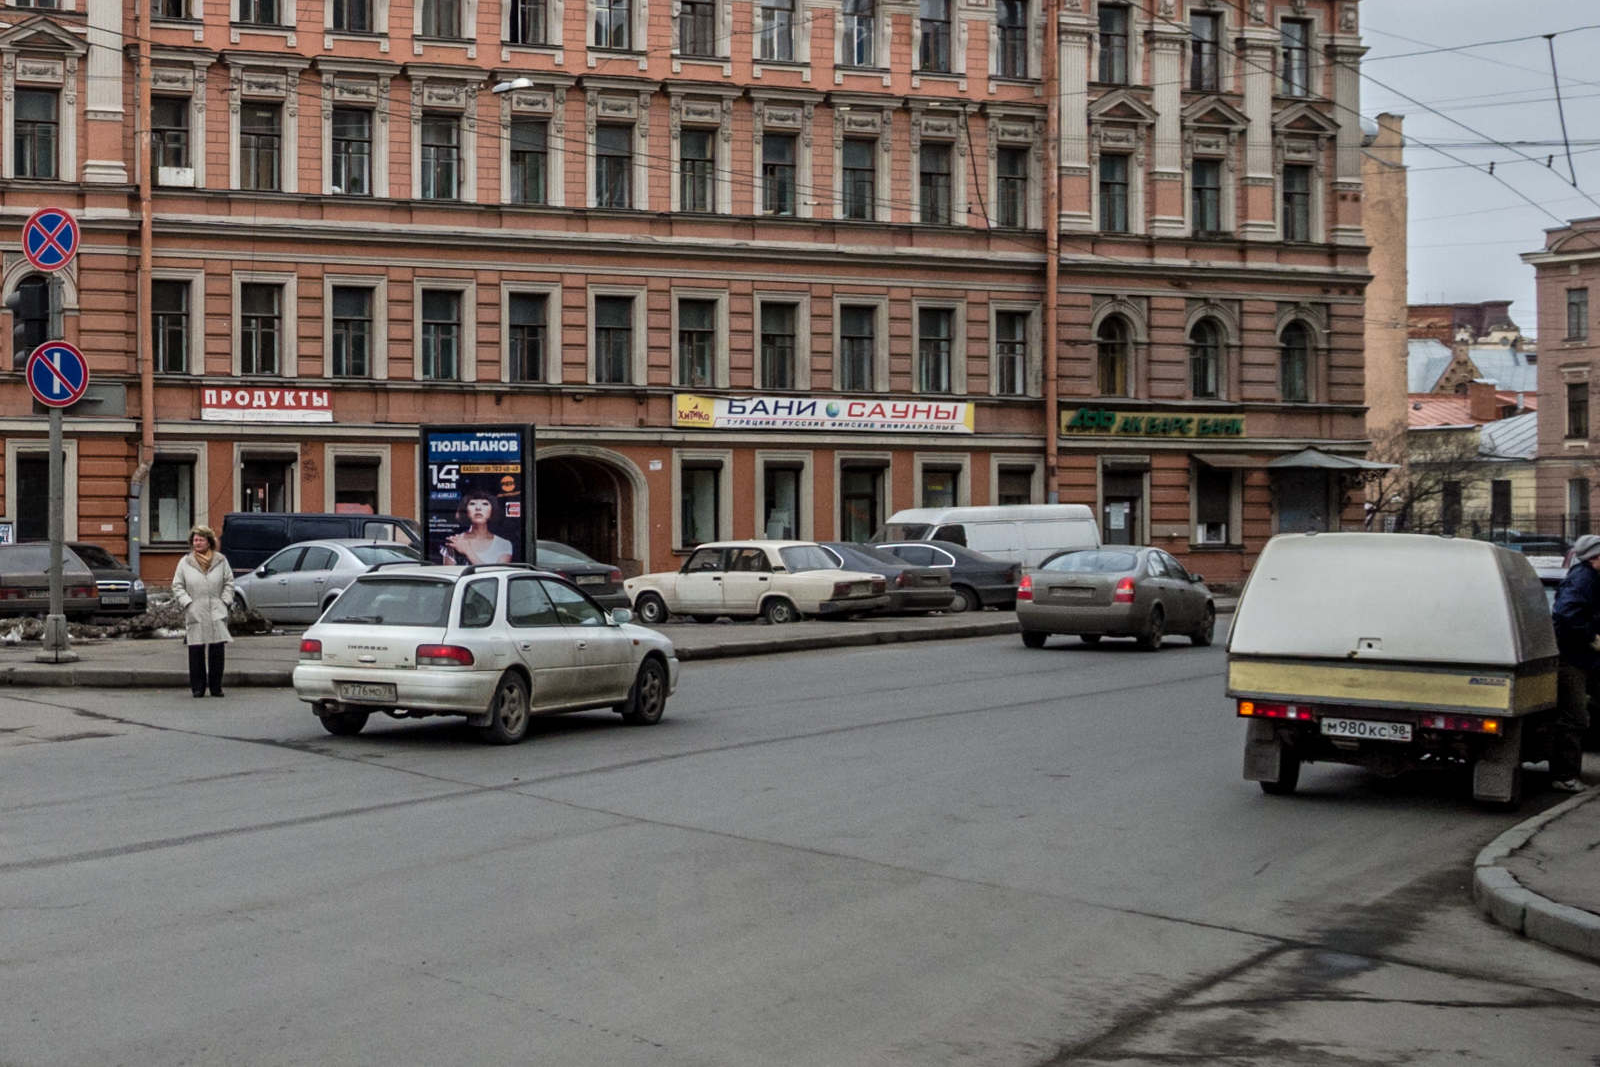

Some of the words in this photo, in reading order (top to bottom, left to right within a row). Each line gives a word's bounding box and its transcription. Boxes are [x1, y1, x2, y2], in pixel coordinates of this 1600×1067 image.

[205, 389, 328, 408] ПРОДУКТЫ
[727, 399, 817, 416] БАНИ
[847, 402, 958, 420] САУНЫ
[727, 419, 777, 427] ТУРЕЦКИЕ
[880, 423, 955, 431] ИНФРАКРАСНЫЕ
[1119, 416, 1143, 433] АК
[1146, 417, 1194, 434] БАРС
[1199, 418, 1244, 434] БАНК
[430, 440, 518, 452] ТЮЛЬПАНОВ
[428, 464, 459, 486] 14
[1327, 720, 1387, 737] М980КС
[1391, 724, 1405, 735] 98
